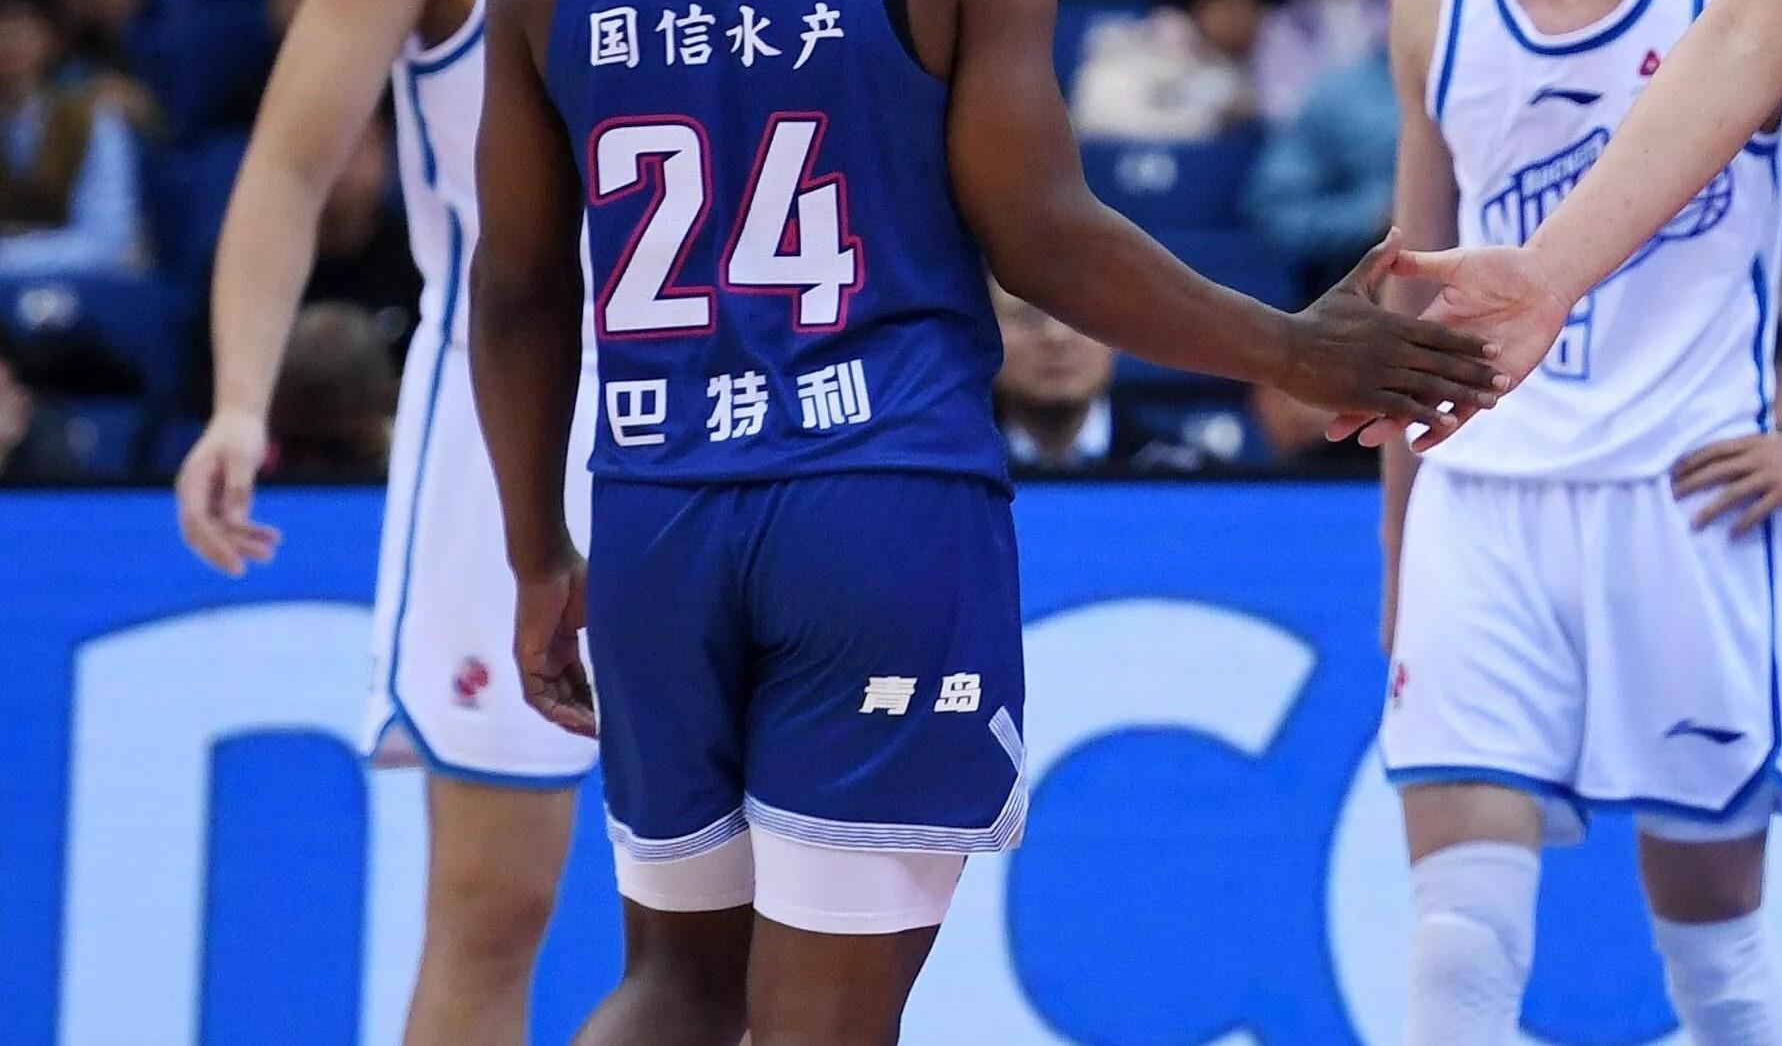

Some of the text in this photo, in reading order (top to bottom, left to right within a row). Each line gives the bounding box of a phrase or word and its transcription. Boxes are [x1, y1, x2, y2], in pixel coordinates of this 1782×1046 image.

[589, 2, 846, 70] 国信水产
[588, 111, 865, 340] 24
[605, 359, 873, 447] 巴特利
[858, 672, 984, 715] 青岛
